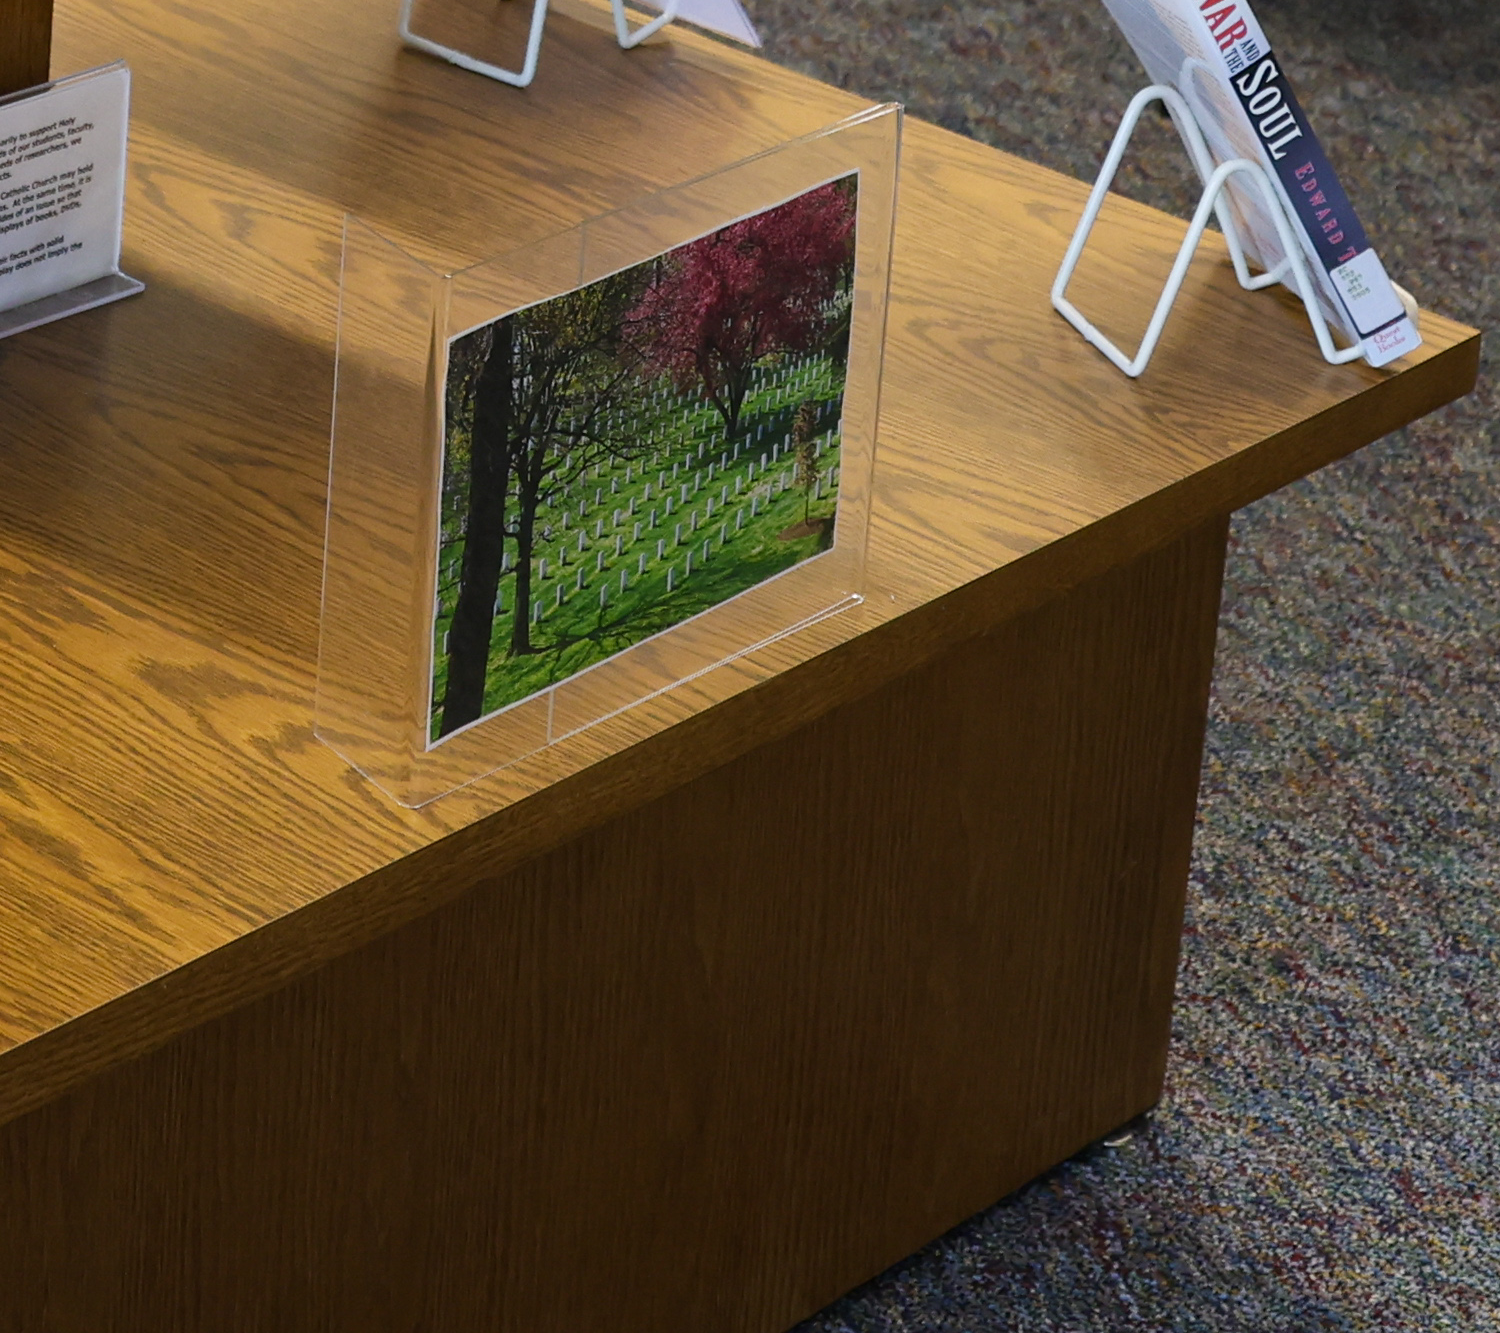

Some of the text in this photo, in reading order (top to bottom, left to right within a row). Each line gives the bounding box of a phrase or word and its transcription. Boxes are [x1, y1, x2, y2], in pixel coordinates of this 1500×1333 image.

[1223, 48, 1245, 74] THE
[1240, 38, 1261, 63] AND
[1236, 59, 1303, 161] SOUL
[1294, 161, 1345, 245] EDWARD
